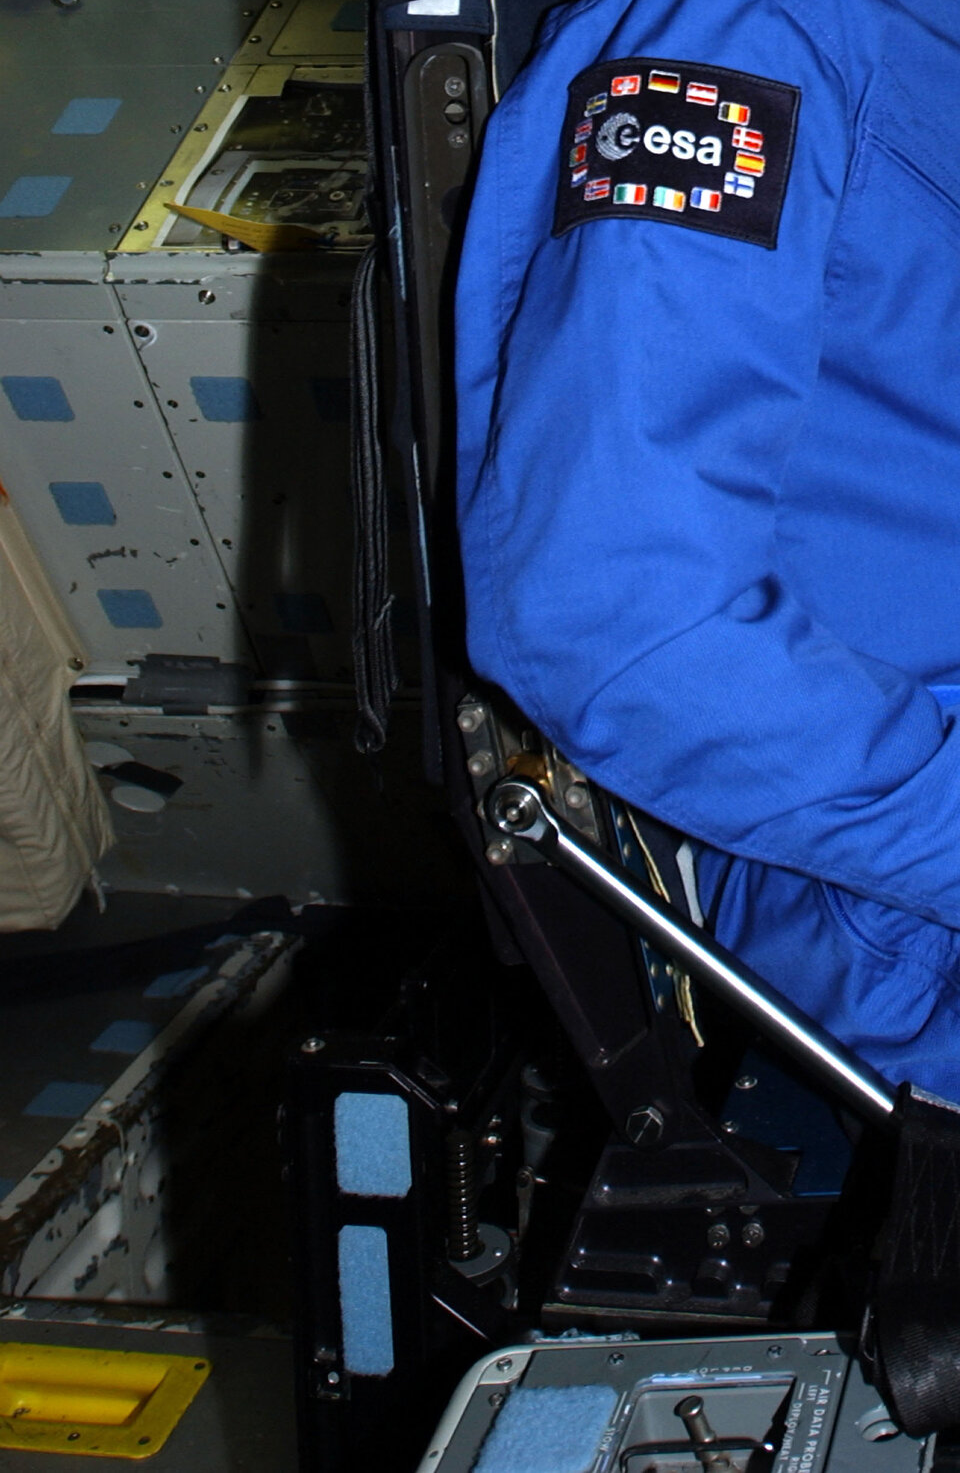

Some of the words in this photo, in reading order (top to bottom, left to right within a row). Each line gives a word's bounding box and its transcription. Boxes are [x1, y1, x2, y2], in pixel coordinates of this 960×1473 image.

[643, 124, 723, 167] esa
[806, 1385, 817, 1402] LEFT
[816, 1388, 830, 1405] AIR
[780, 1402, 803, 1461] DEPLOY/HEAT
[808, 1409, 826, 1437] DATA
[600, 1427, 616, 1452] STOW
